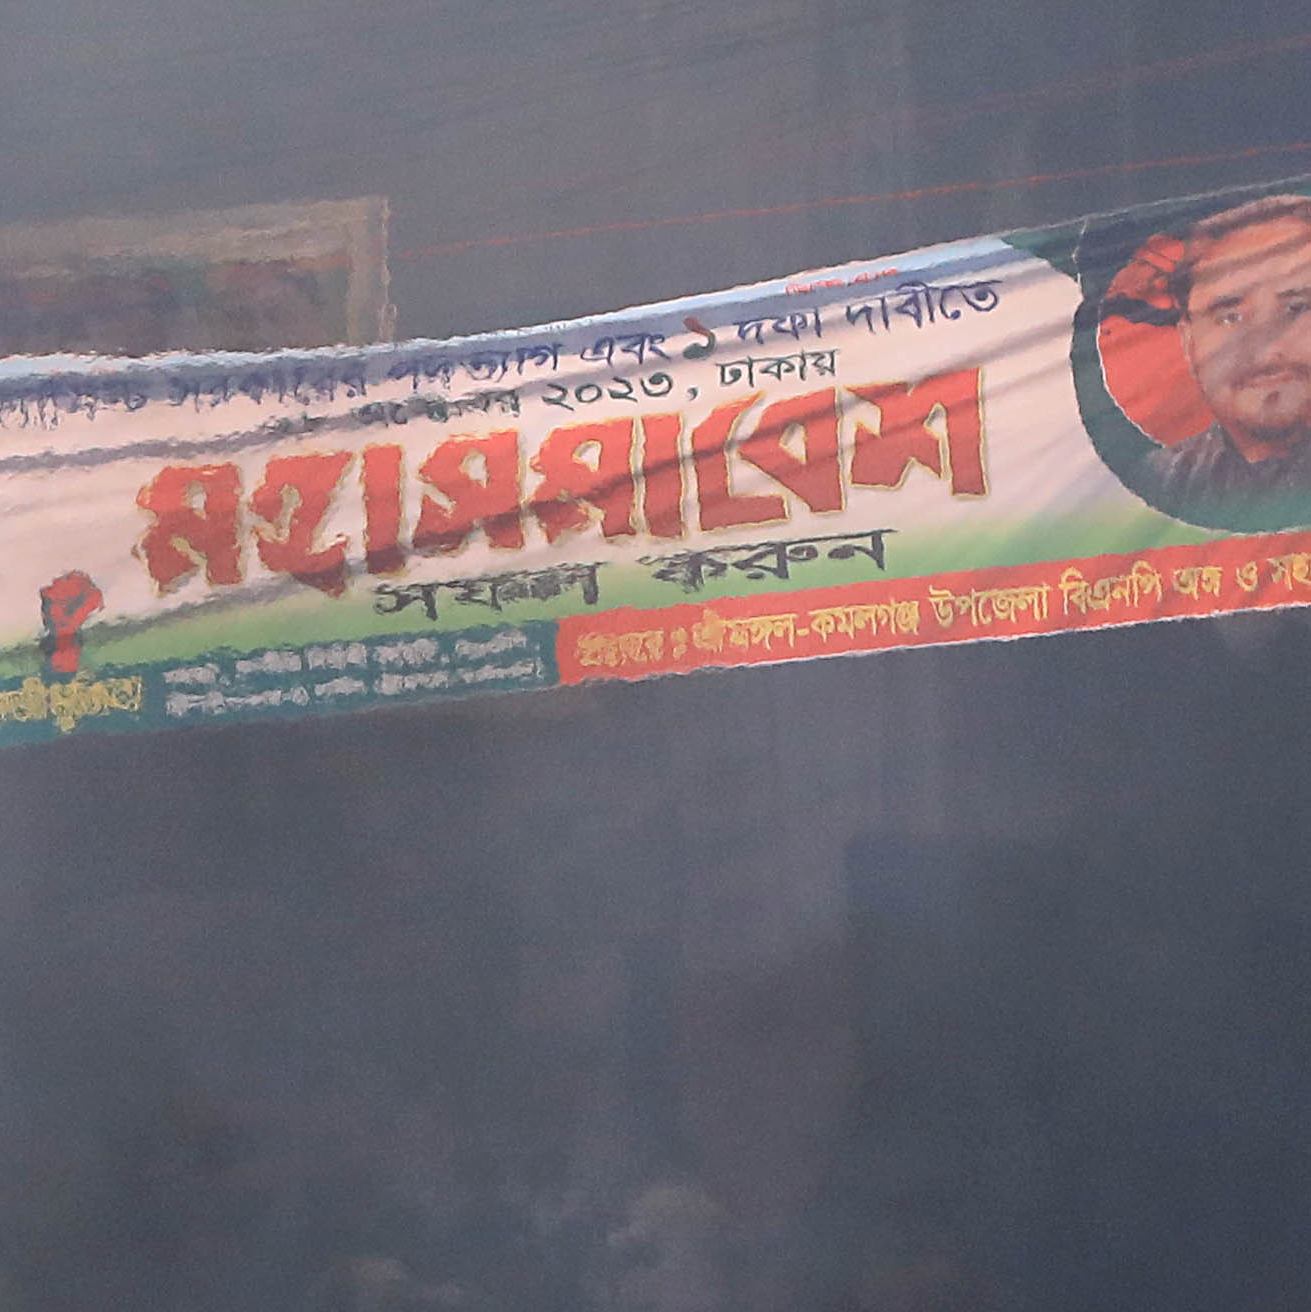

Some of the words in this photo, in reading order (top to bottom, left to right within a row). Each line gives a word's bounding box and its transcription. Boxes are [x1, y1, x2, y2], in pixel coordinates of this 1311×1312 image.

[580, 333, 671, 367] এবং
[682, 316, 716, 359] ১
[846, 279, 1005, 336] দাবীতে
[717, 348, 840, 387] ঢাকায়
[928, 583, 1052, 629] উপজেলা
